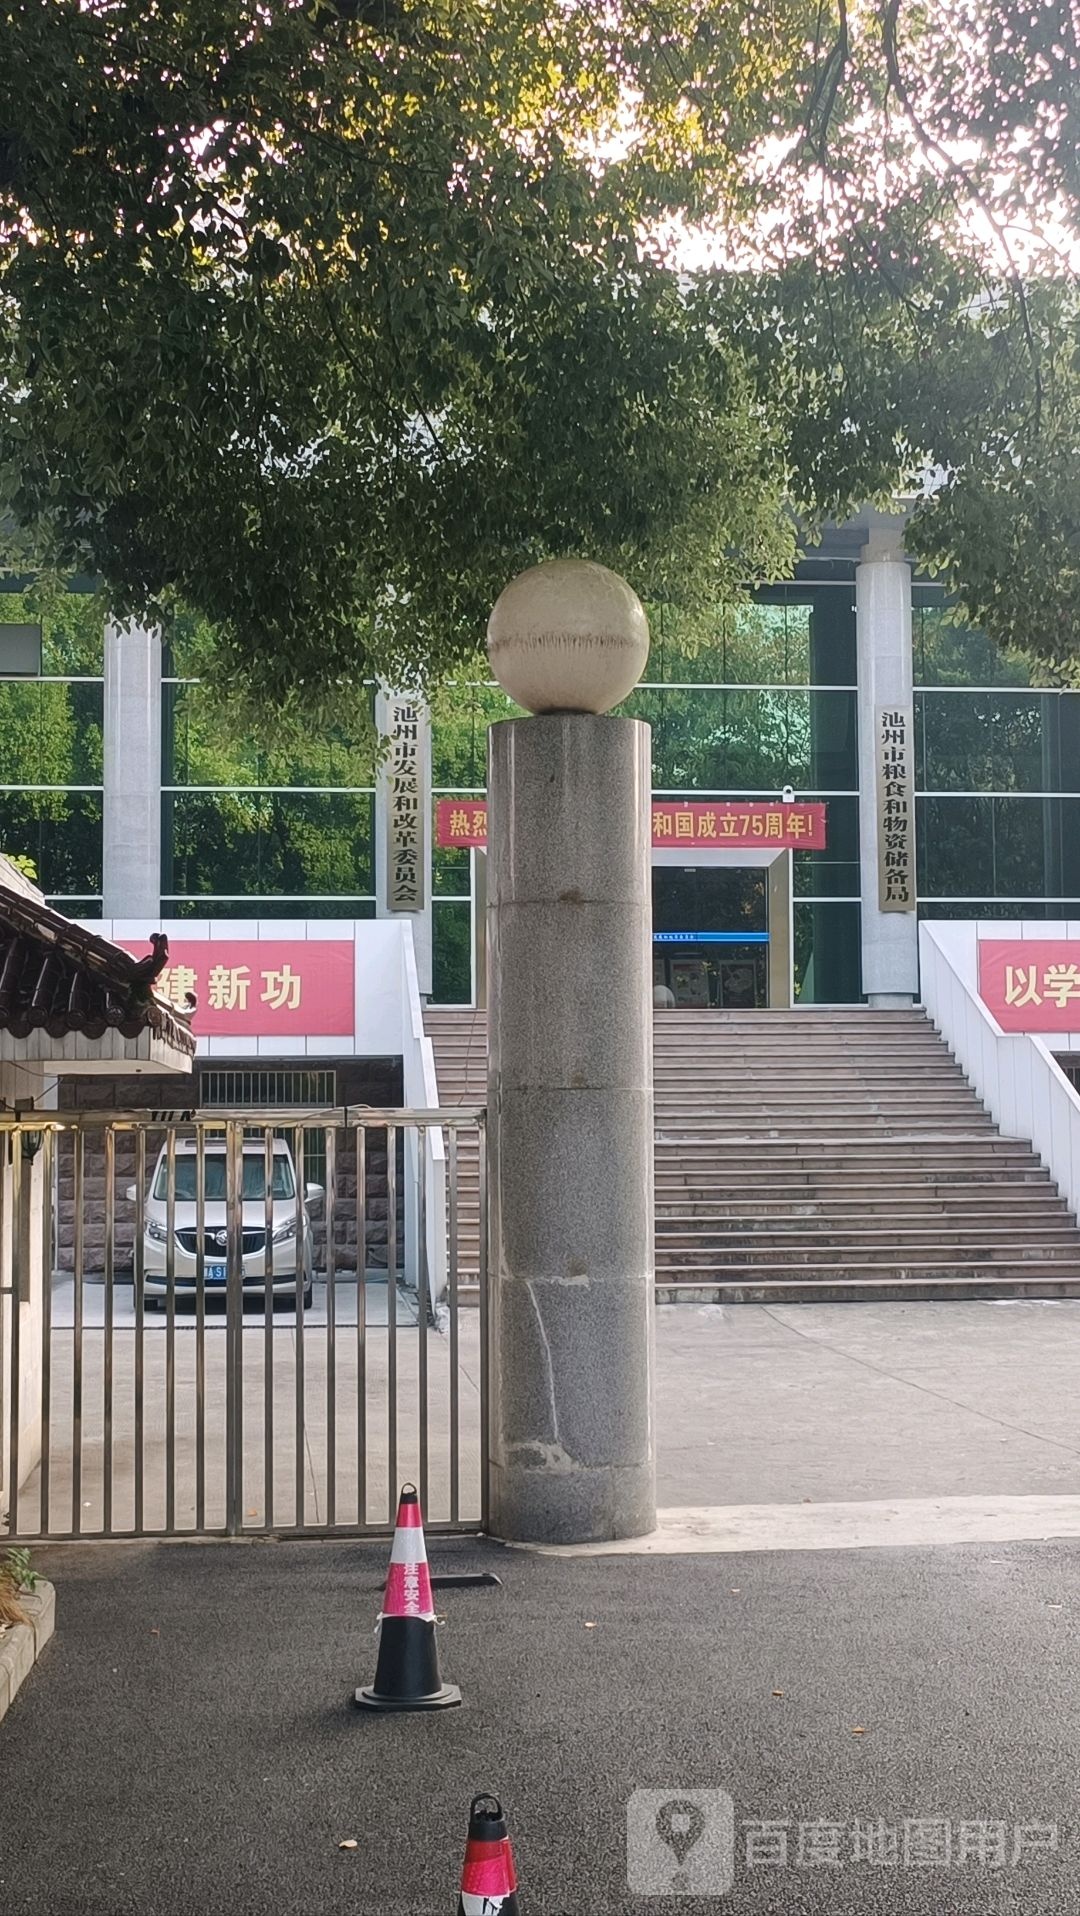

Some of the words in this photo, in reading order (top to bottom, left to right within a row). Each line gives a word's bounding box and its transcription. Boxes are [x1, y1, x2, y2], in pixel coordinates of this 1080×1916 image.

[392, 705, 419, 902] 池州市发展和改革委员会
[450, 809, 488, 837] 热烈
[653, 810, 813, 840] 和国成立75周年!
[881, 711, 909, 903] 池州市粮食和物资储备局
[154, 964, 302, 1010] 建新功
[1004, 963, 1080, 1008] 以学
[403, 1561, 420, 1615] 注意安全
